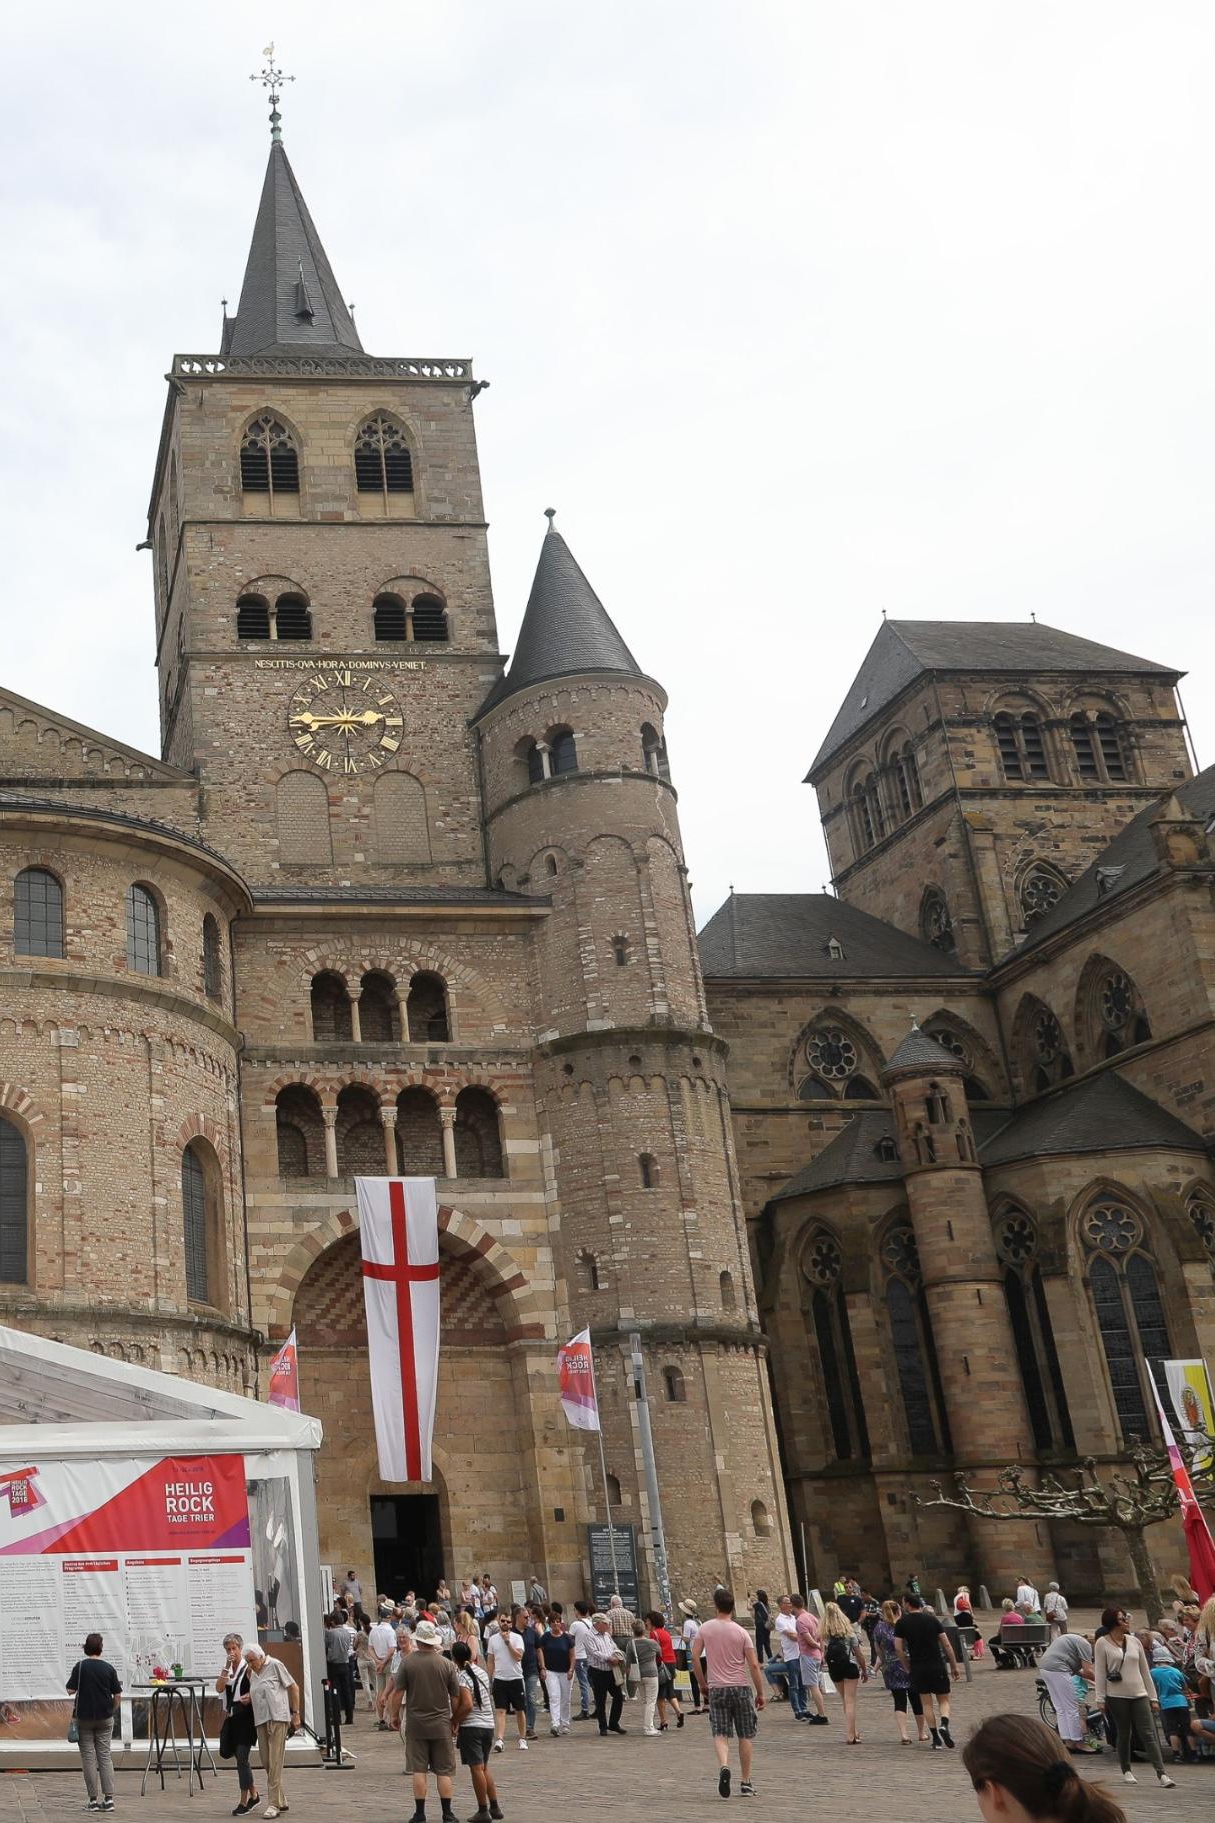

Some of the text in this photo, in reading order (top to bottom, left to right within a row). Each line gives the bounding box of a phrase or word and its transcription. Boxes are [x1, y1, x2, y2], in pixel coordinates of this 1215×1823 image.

[164, 1481, 214, 1496] HEILIG
[166, 1497, 215, 1513] ROCK
[167, 1513, 215, 1523] TAGE TRIER
